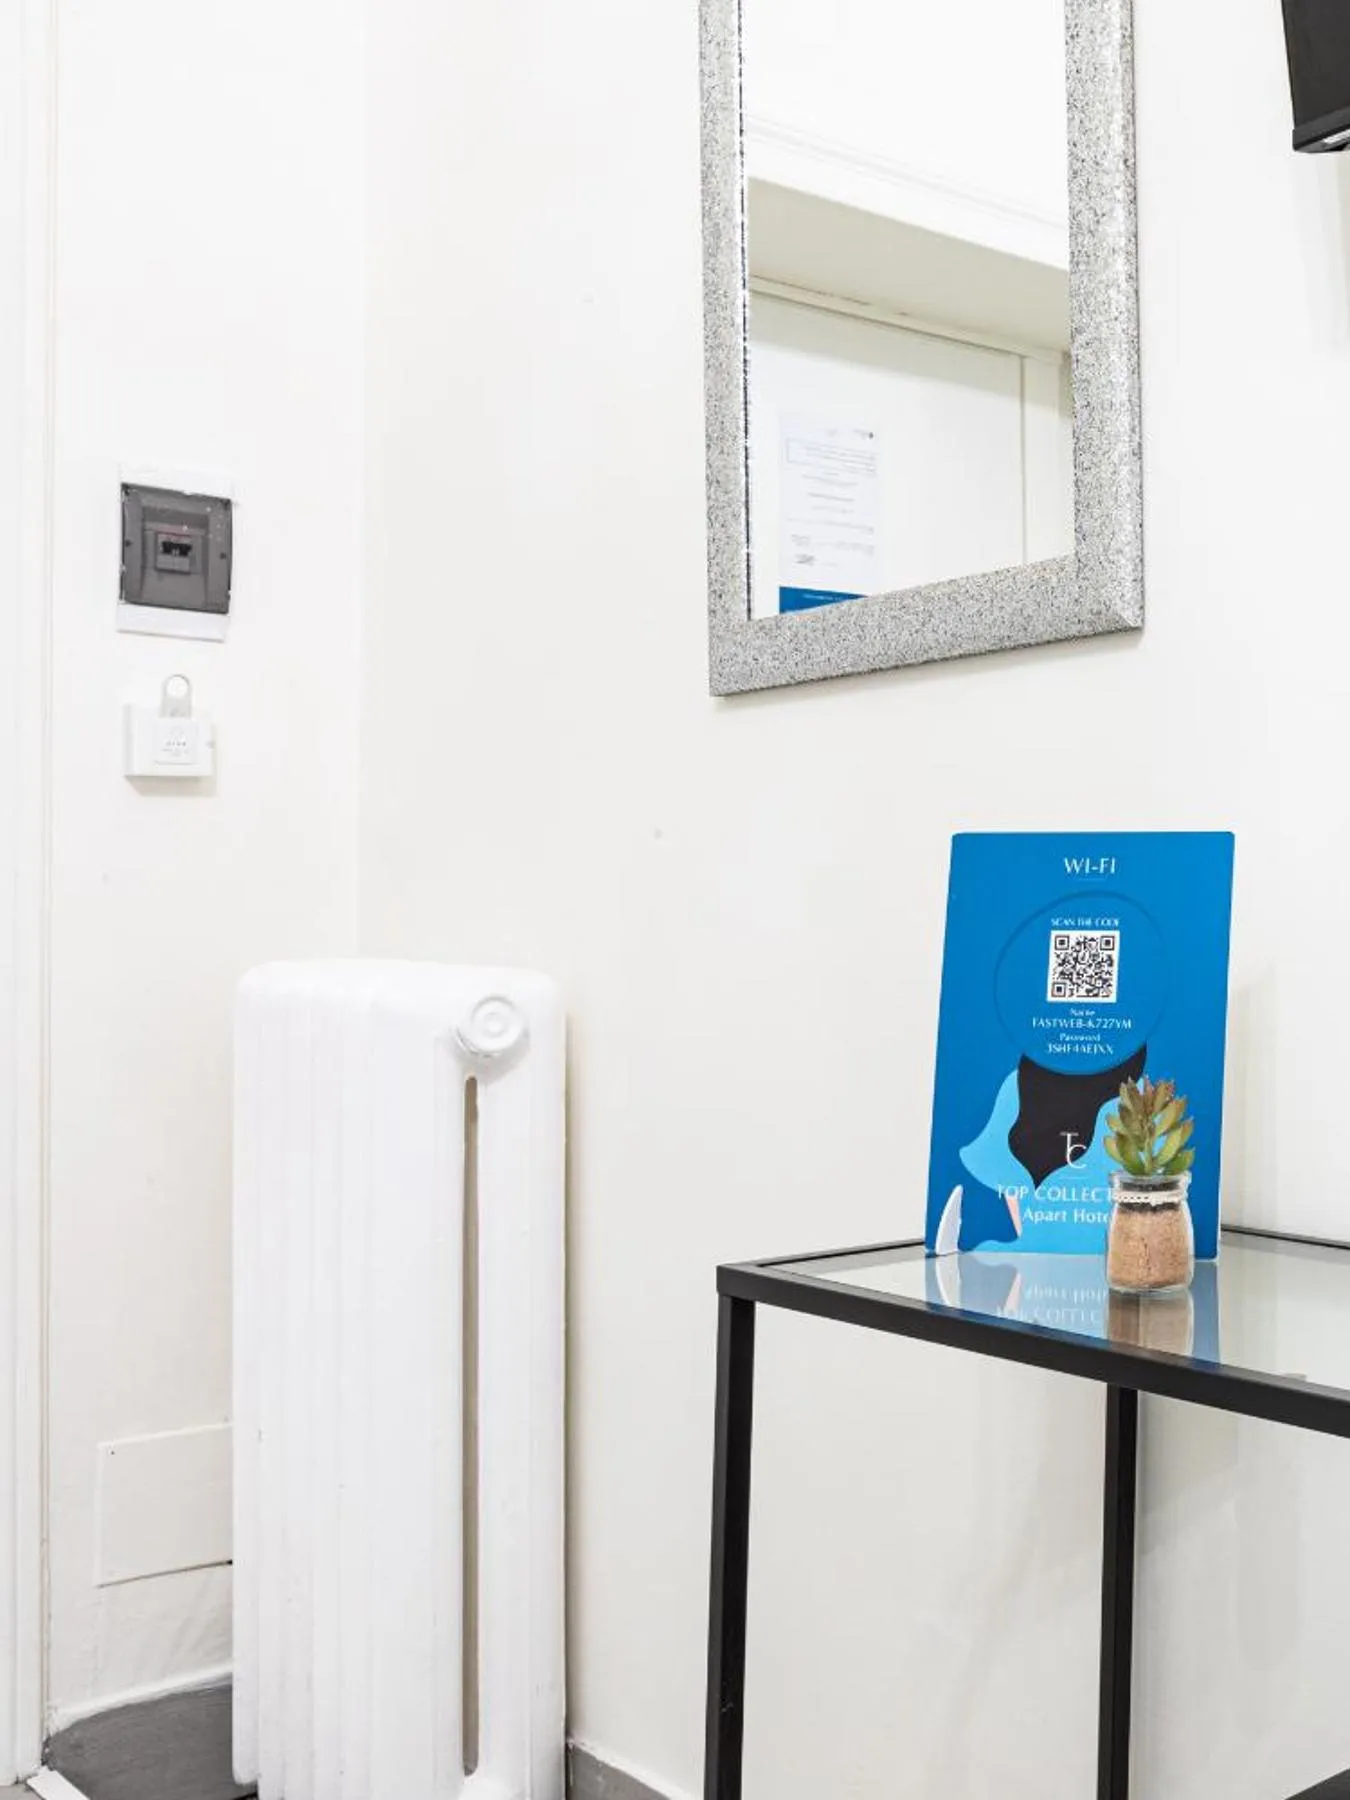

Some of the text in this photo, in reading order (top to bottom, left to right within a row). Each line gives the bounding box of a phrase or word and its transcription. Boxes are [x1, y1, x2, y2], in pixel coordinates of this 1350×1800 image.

[1064, 857, 1116, 875] WI-FI
[1060, 1033, 1101, 1042] Password
[997, 1183, 1113, 1202] TOP COLLECT
[1022, 1208, 1109, 1224] Apart Hote
